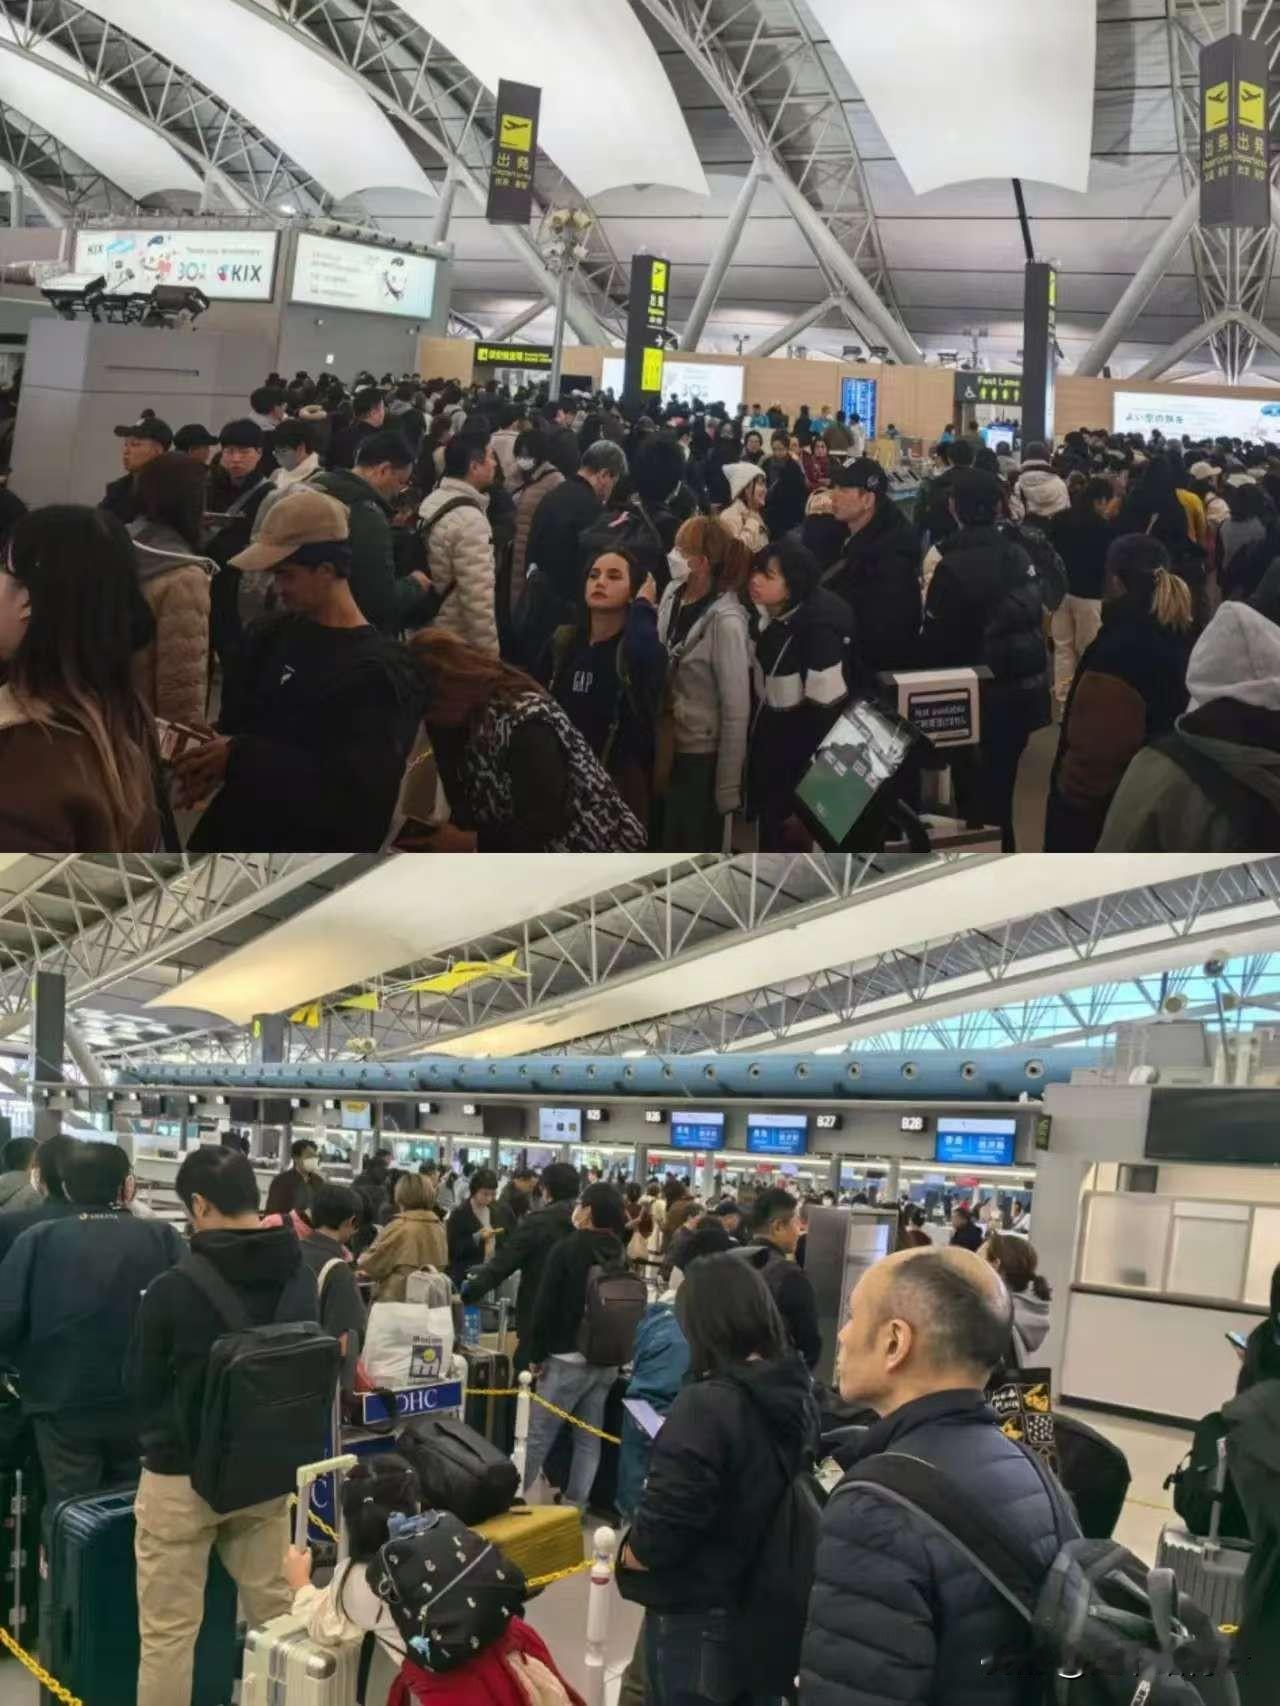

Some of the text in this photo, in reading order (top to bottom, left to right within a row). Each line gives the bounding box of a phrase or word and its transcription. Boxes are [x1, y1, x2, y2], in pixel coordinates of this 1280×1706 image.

[231, 264, 263, 282] KIX
[572, 670, 593, 693] GAP
[816, 1114, 837, 1128] B27
[901, 1116, 924, 1130] B28
